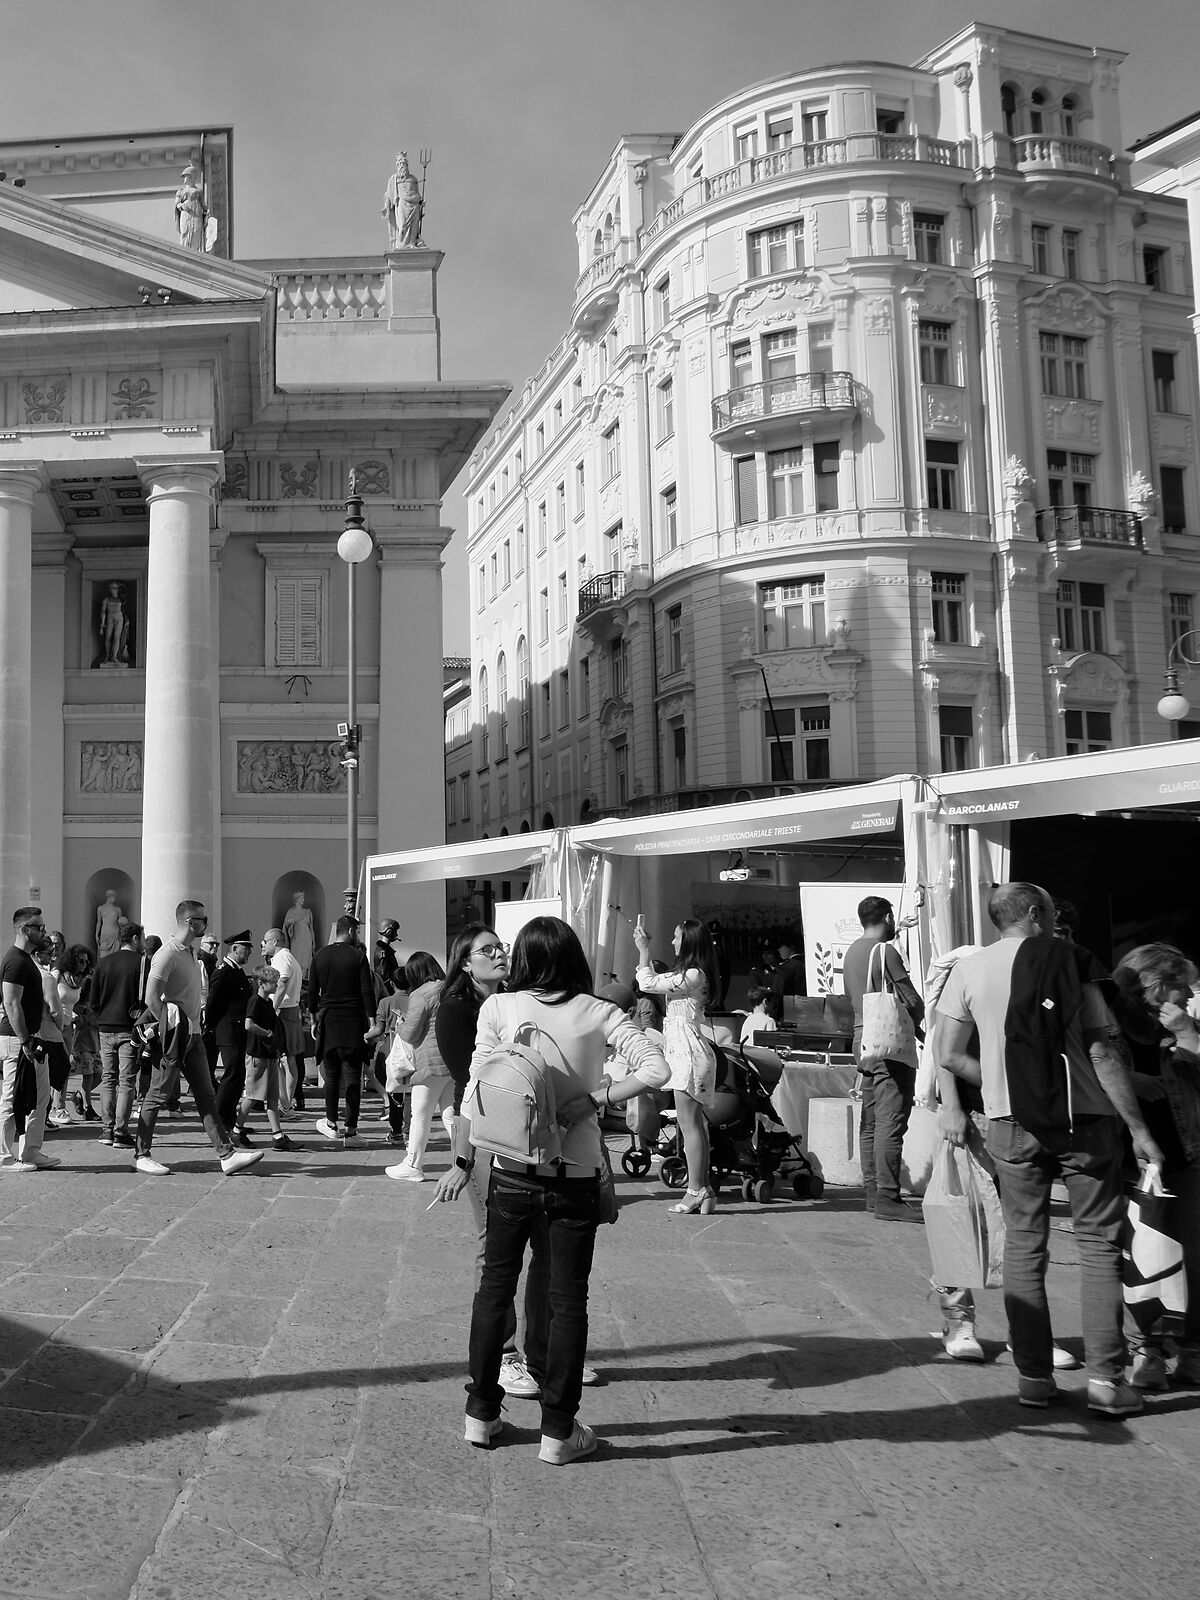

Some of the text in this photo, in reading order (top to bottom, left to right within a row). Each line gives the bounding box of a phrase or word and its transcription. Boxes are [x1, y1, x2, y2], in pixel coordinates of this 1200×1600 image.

[1159, 779, 1200, 794] GUARD
[861, 817, 895, 830] GENERALI
[705, 834, 721, 844] CASA
[722, 828, 772, 842] CIRCONDARIALE
[774, 824, 802, 836] TRIESTE
